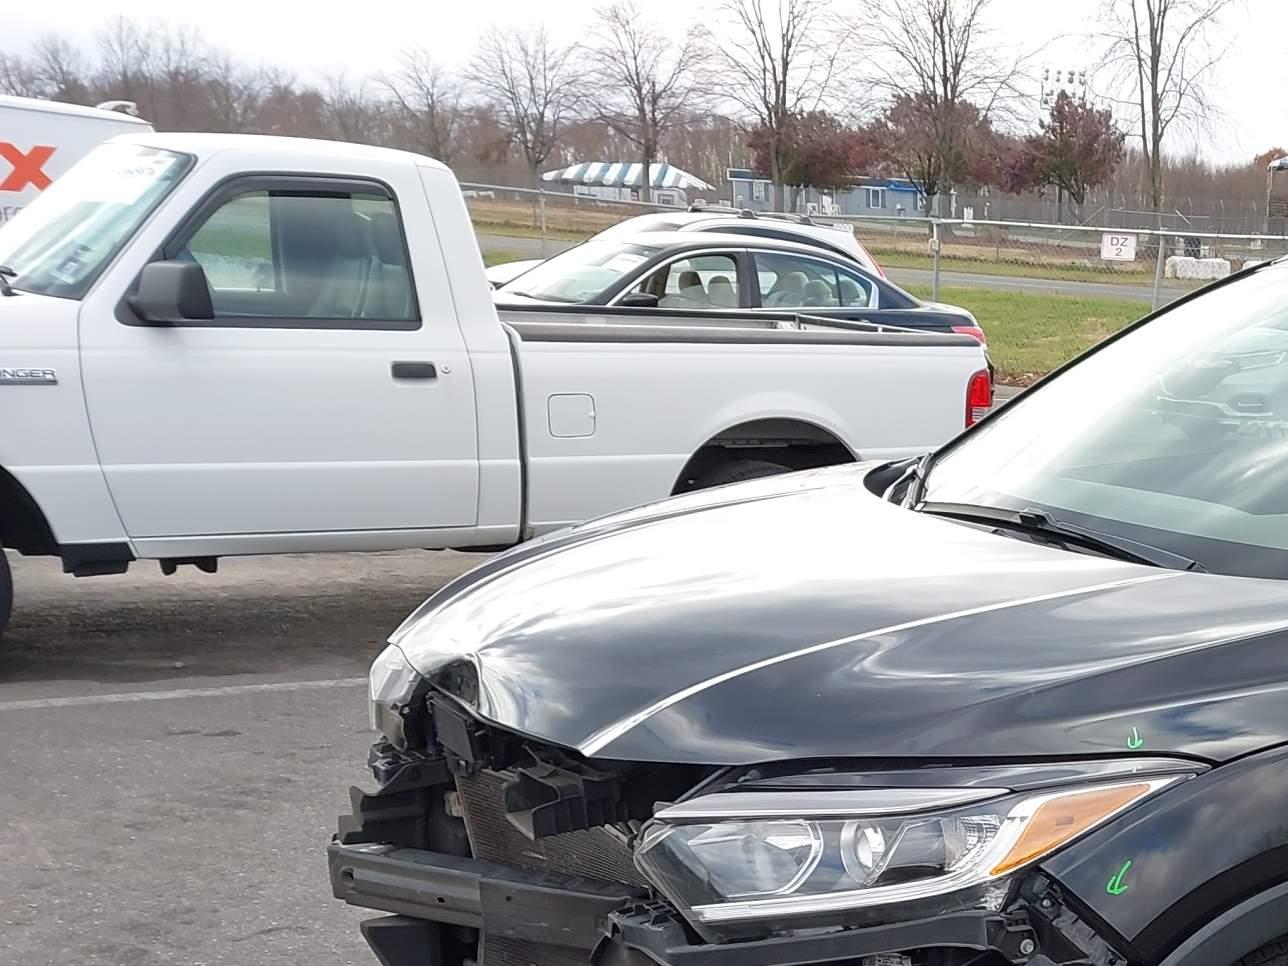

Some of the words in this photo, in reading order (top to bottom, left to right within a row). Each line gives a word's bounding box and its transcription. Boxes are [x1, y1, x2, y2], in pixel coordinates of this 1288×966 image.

[1110, 236, 1129, 247] DZ
[1114, 247, 1123, 257] 2
[0, 368, 57, 379] NGER
